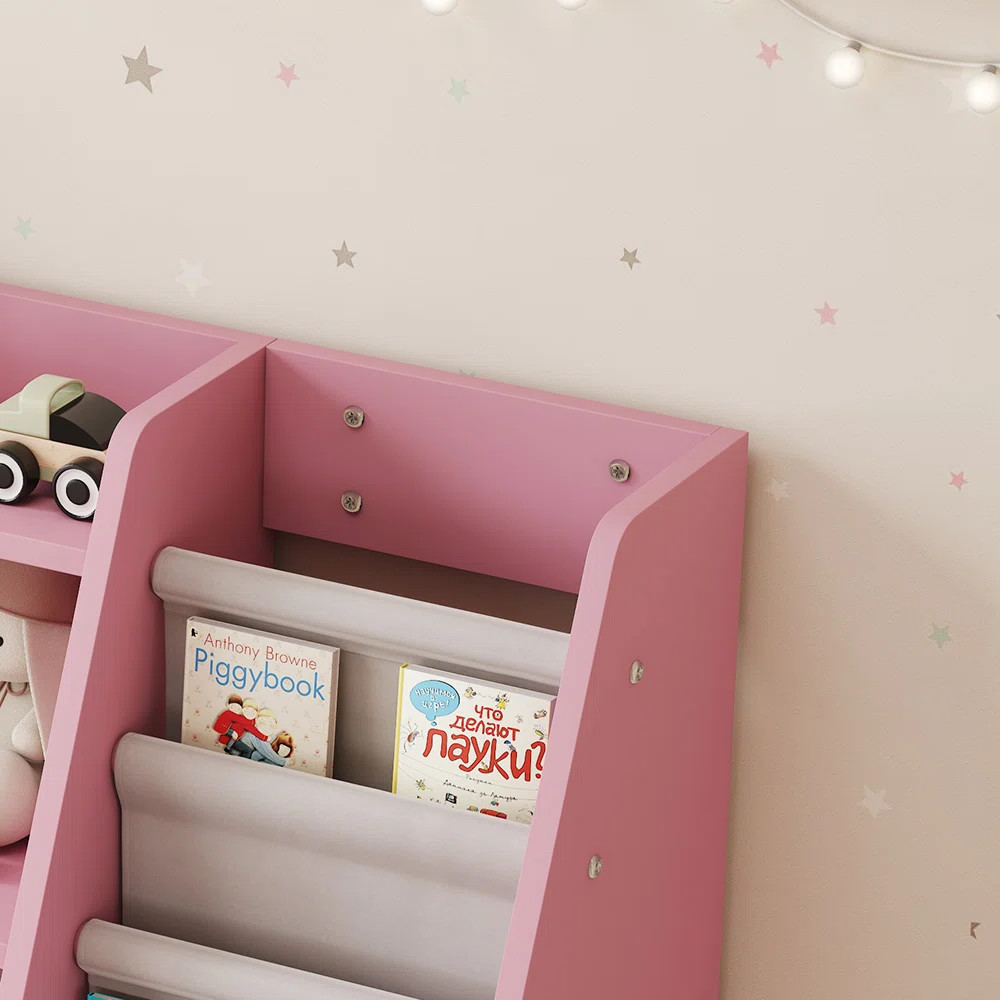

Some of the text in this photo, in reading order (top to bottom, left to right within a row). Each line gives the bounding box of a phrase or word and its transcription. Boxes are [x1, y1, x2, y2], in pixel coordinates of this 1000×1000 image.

[194, 647, 325, 701] Piggybook
[203, 633, 317, 670] Anthony Browne
